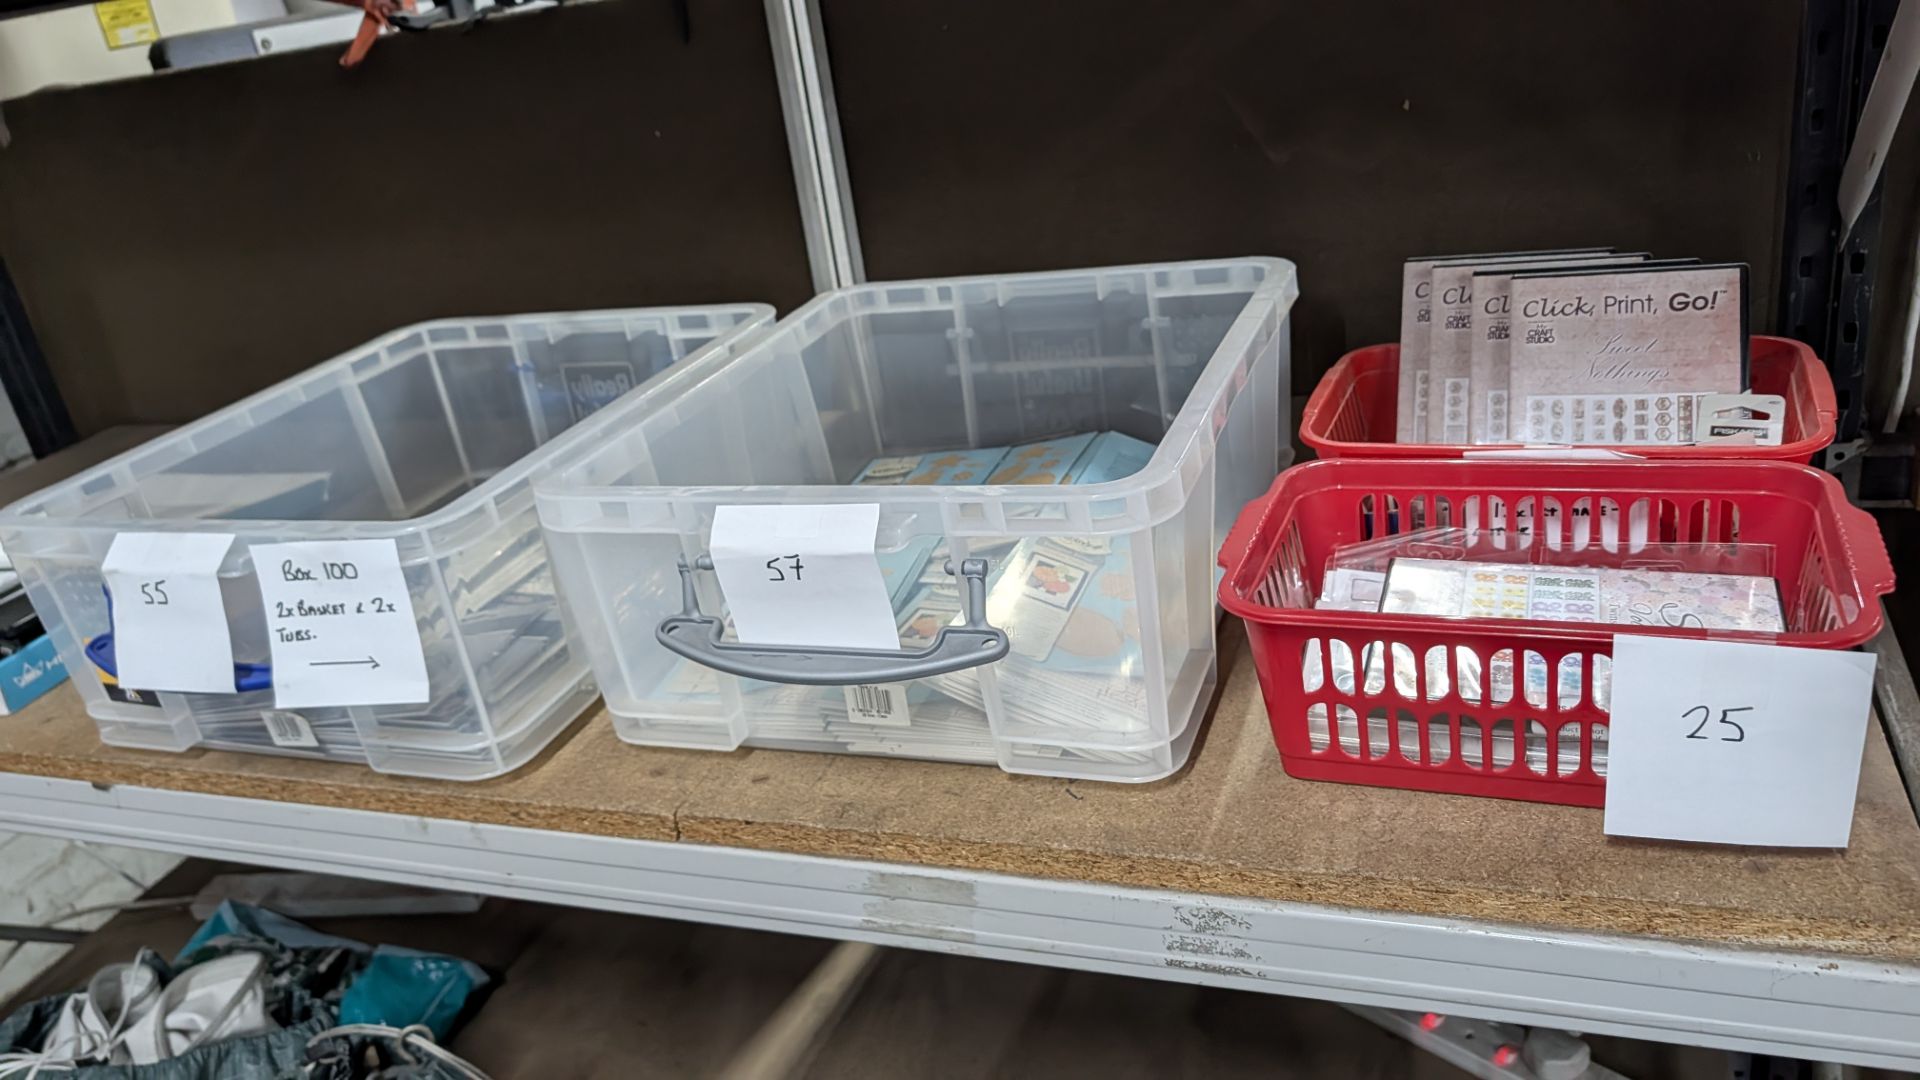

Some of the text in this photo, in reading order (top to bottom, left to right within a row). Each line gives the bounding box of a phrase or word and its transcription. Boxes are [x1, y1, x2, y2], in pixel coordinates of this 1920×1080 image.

[1603, 294, 1659, 315] Print,
[1527, 329, 1554, 337] CRAFT
[282, 559, 359, 582] Box 100
[766, 553, 804, 581] 57
[141, 579, 168, 605] 55
[1681, 705, 1754, 742] 25
